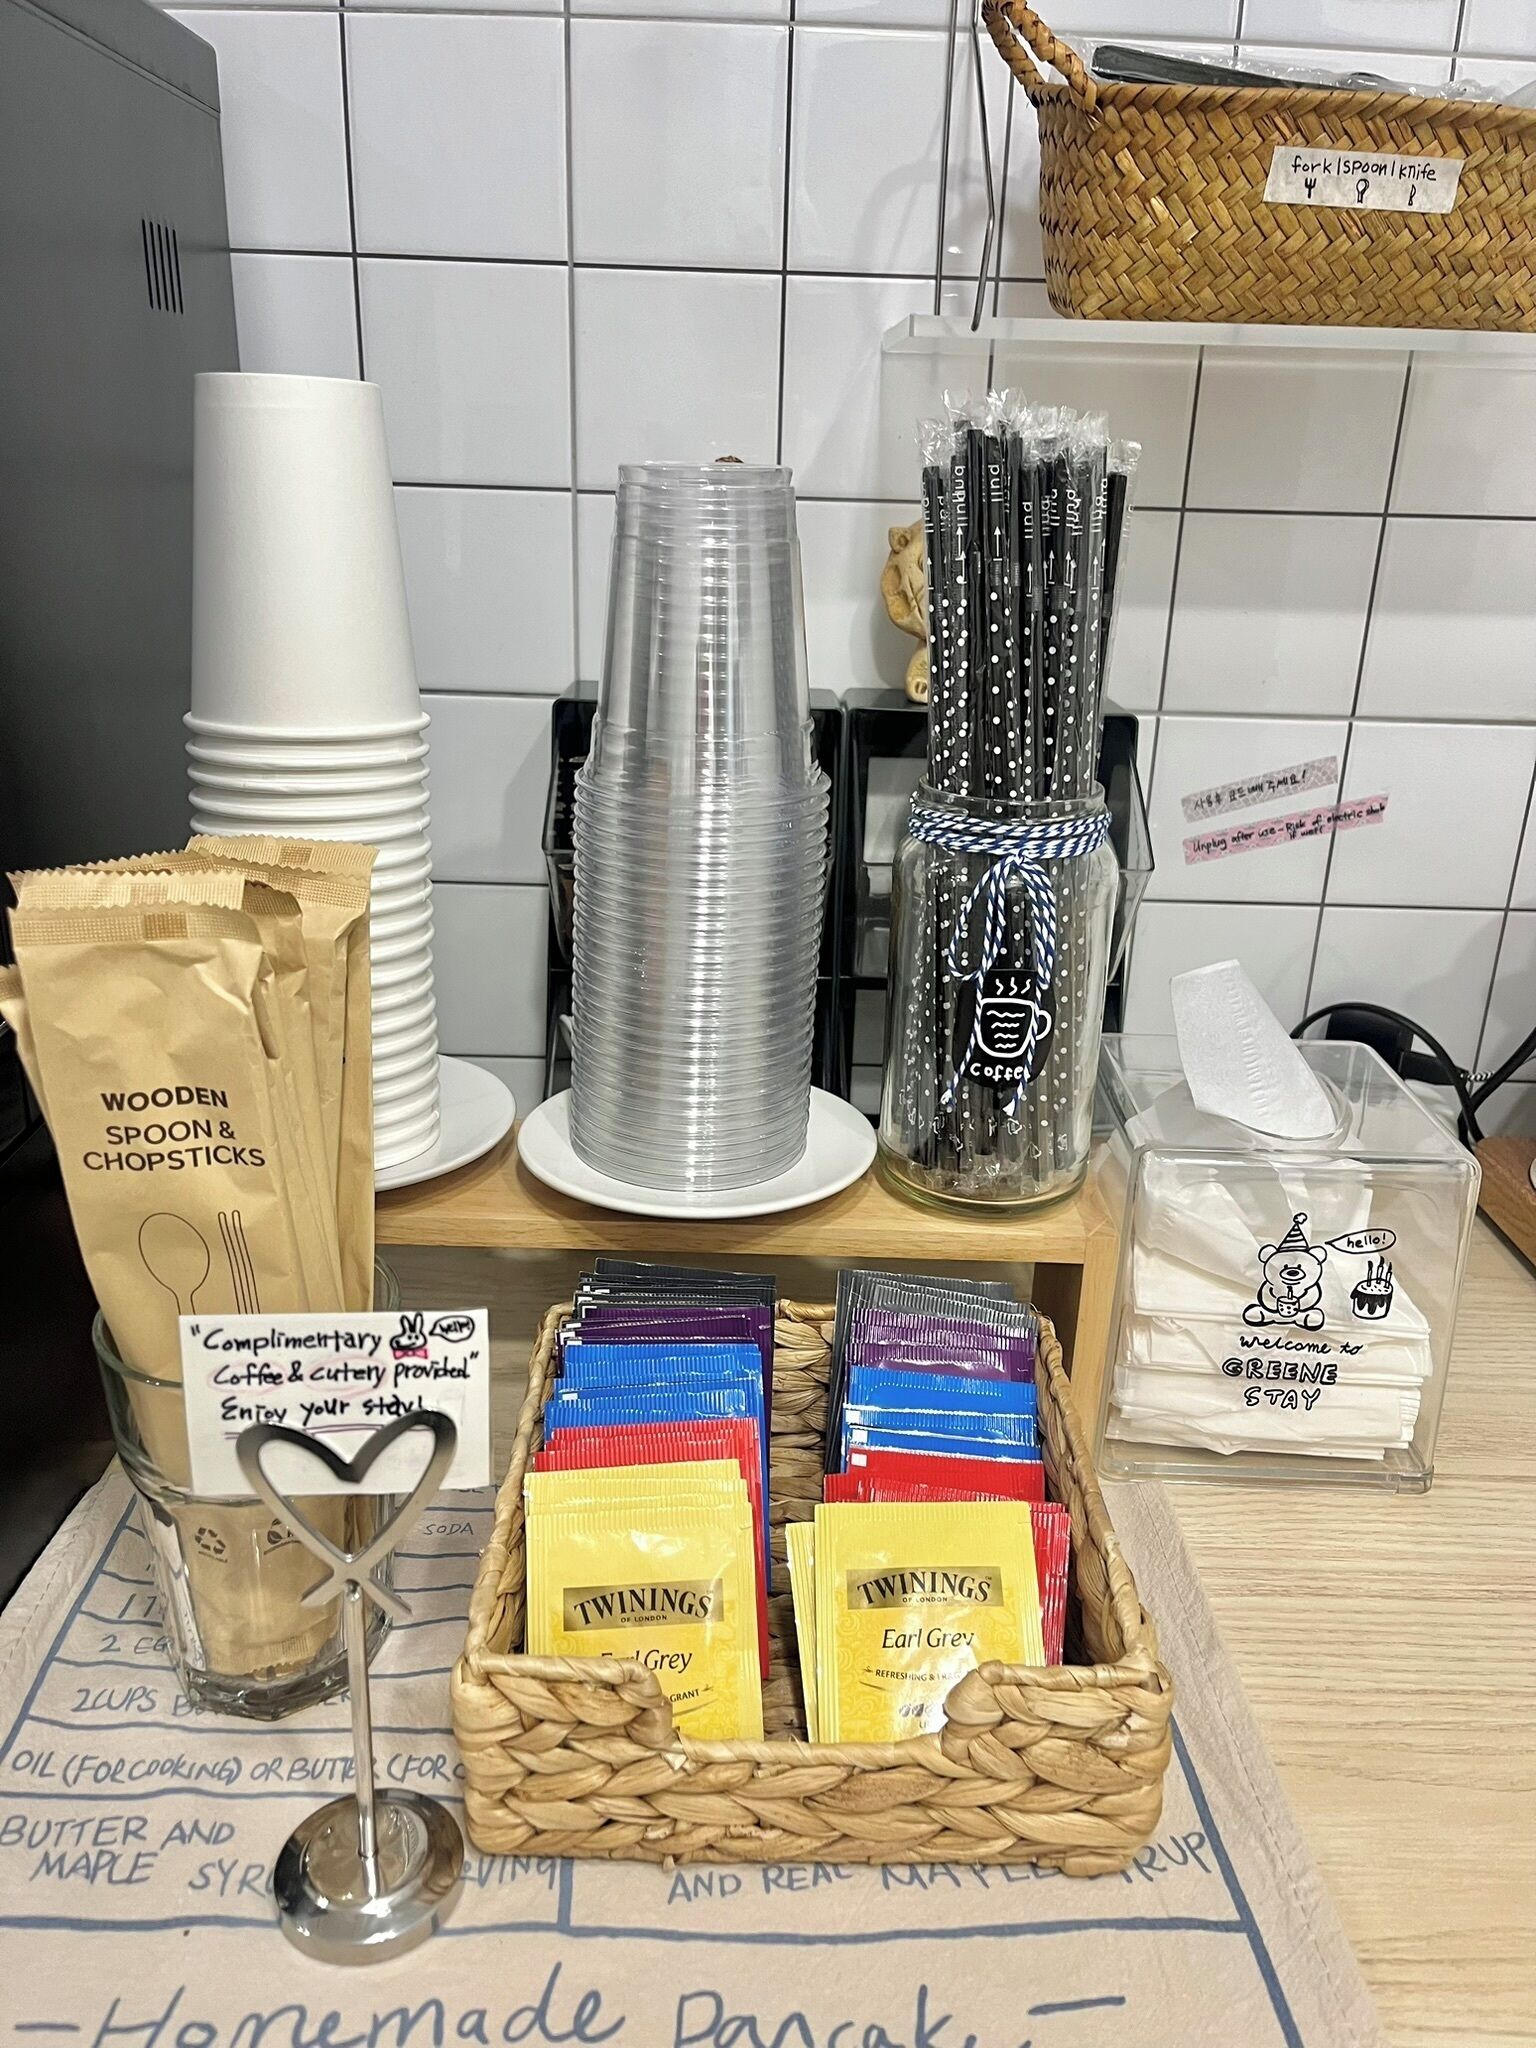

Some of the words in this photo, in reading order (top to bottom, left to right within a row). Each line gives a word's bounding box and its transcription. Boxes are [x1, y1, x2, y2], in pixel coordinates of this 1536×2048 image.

[988, 464, 1005, 502] pull
[1022, 501, 1034, 539] pull
[1193, 837, 1228, 854] Unplug
[1231, 831, 1254, 844] after
[1258, 827, 1276, 838] use
[1312, 814, 1324, 826] of
[1327, 809, 1363, 824] electric
[101, 1085, 229, 1112] WOODEN
[105, 1119, 213, 1146] SPOON
[218, 1119, 236, 1140] &
[83, 1145, 266, 1172] CHOPSTICKS
[1347, 1233, 1387, 1249] hello!
[1239, 1335, 1331, 1355] welcome
[1340, 1341, 1364, 1355] to
[213, 1362, 284, 1387] Coffee
[288, 1361, 304, 1383] &
[1222, 1357, 1338, 1385] GREENE
[222, 1396, 287, 1421] Enjoy
[300, 1398, 350, 1427] your
[1244, 1386, 1321, 1411] STAY
[424, 1522, 474, 1536] SODA
[857, 1571, 991, 1605] TWININGS
[573, 1587, 713, 1626] TWININGS
[634, 1614, 668, 1623] LONDON
[99, 1634, 121, 1653] 2
[881, 1628, 922, 1649] Earl
[644, 1649, 693, 1674] Grey
[669, 1689, 700, 1703] GRANT
[12, 1750, 56, 1778] OIL
[250, 1757, 283, 1782] OR
[386, 1753, 452, 1784] (FOR
[0, 1814, 149, 1849] BUTTER
[159, 1819, 236, 1851] AND
[29, 1850, 159, 1885] MAPLE
[667, 1870, 743, 1904] AND
[671, 1983, 1032, 2048] Pancak
